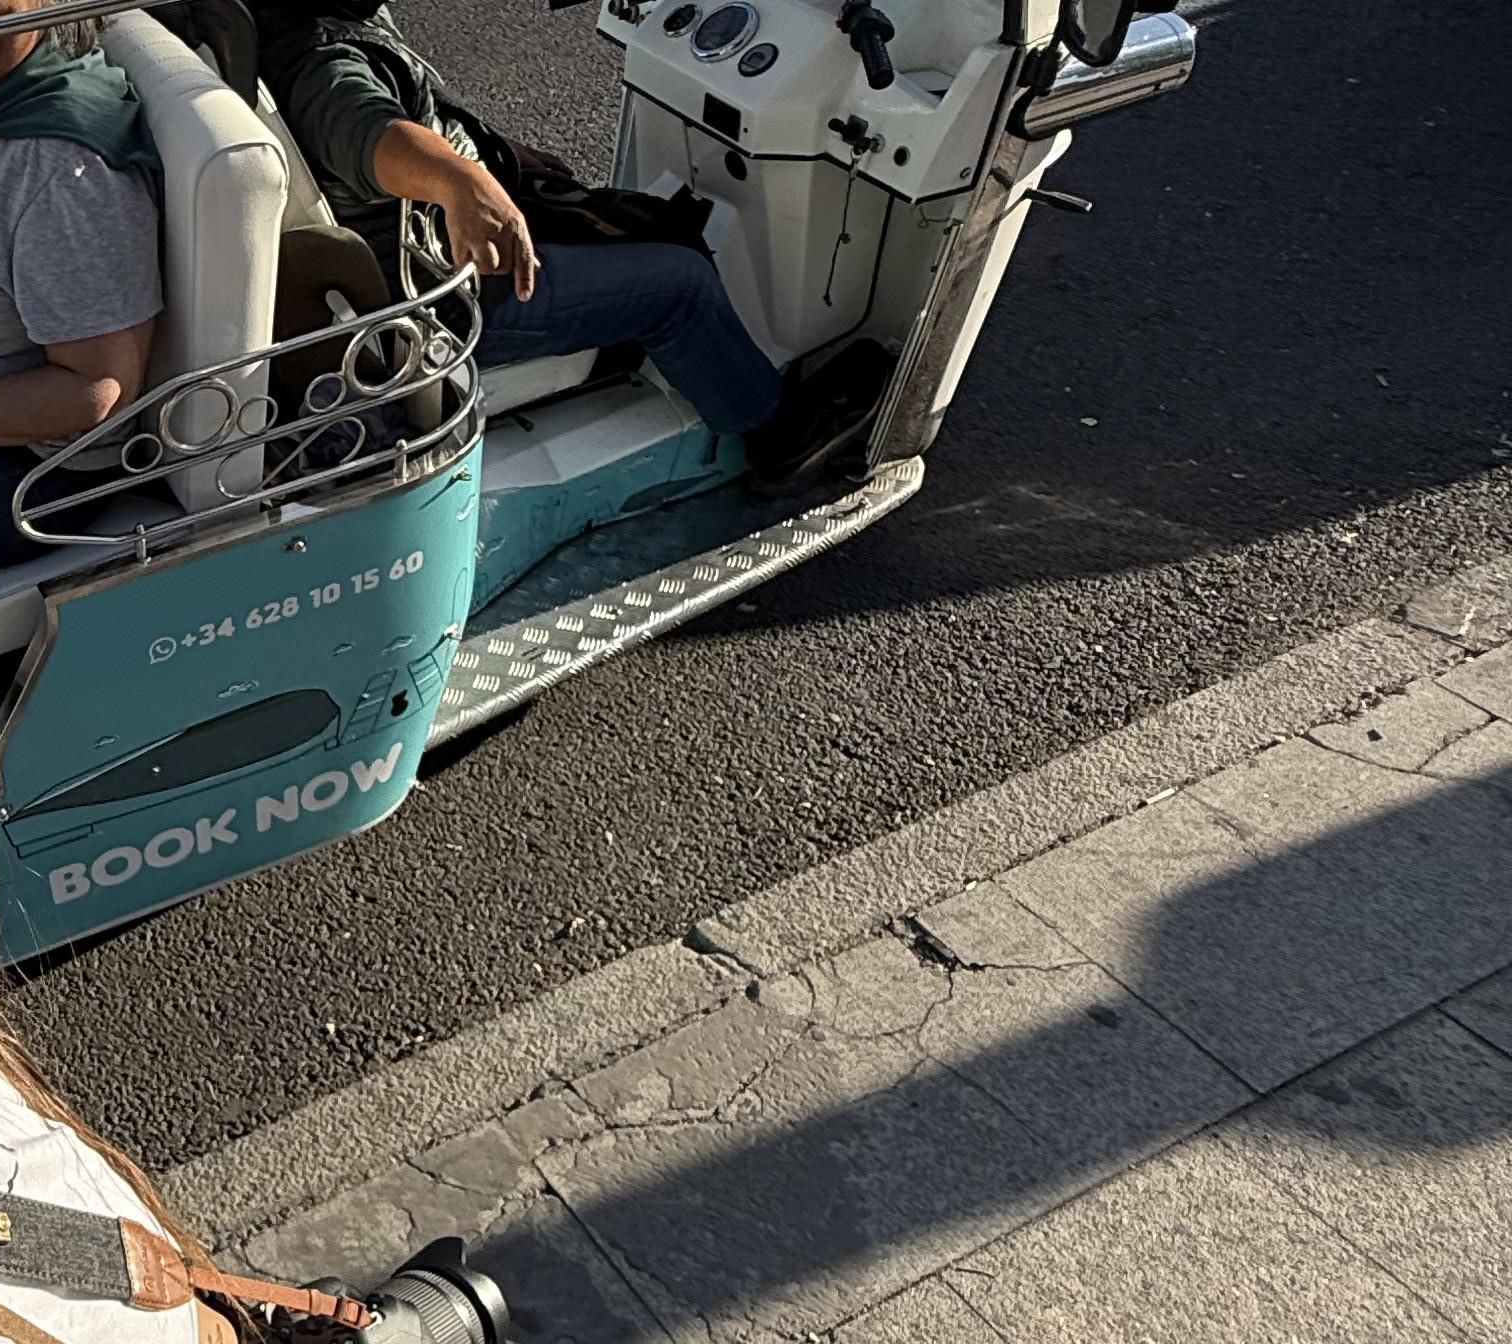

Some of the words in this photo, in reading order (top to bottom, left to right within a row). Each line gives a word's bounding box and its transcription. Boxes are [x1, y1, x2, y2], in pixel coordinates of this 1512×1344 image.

[181, 617, 236, 648] +34
[245, 596, 301, 630] 628
[309, 582, 341, 609] 10
[350, 568, 380, 594] 15
[388, 550, 424, 581] 60
[48, 808, 239, 905] BOOK
[255, 742, 403, 833] NOW
